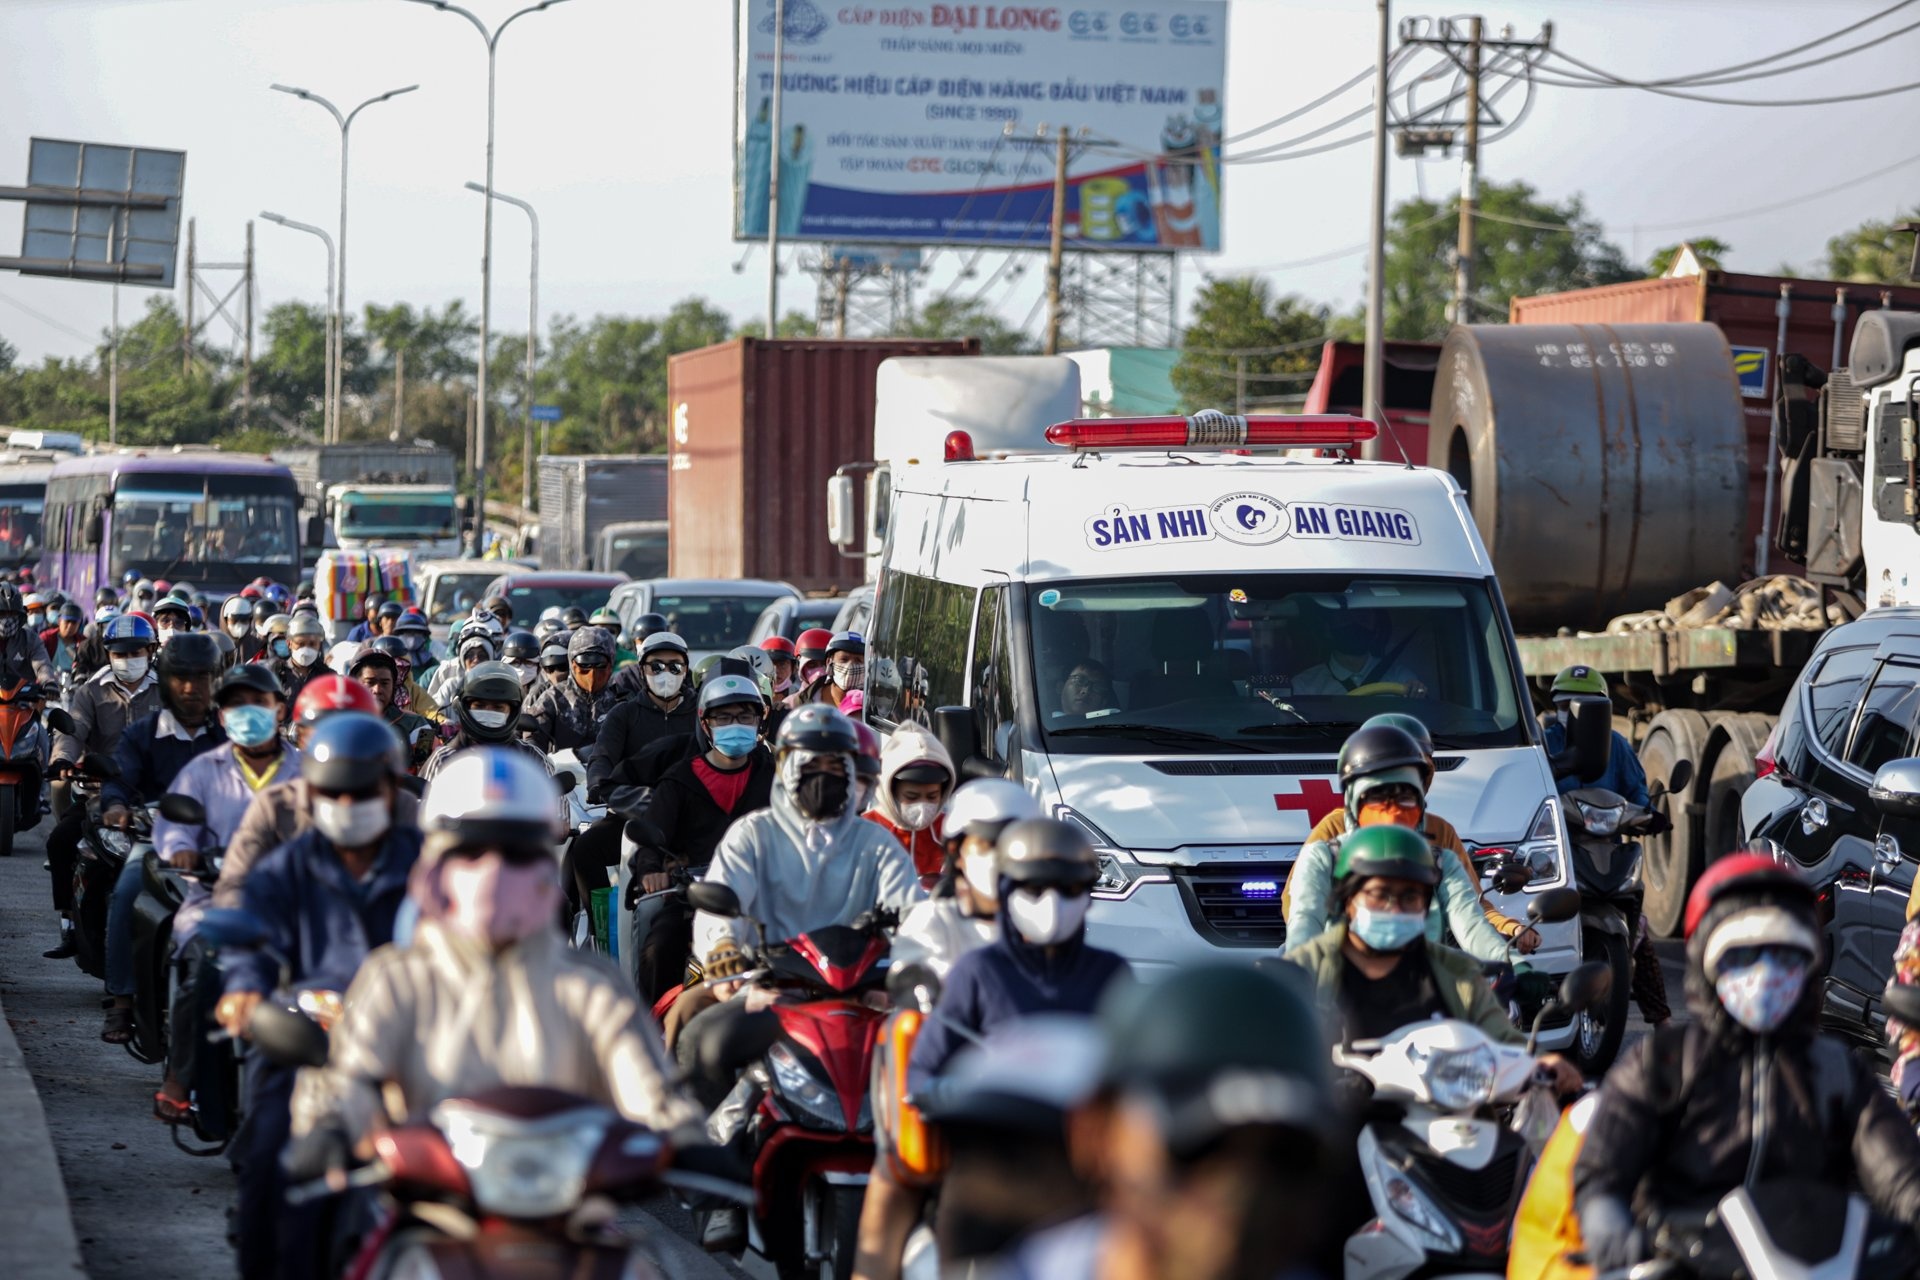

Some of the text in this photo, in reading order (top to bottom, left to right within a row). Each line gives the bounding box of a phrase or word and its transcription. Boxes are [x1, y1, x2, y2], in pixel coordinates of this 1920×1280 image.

[931, 4, 981, 34] ĐẠI
[985, 6, 1062, 32] LONG
[1139, 86, 1186, 104] NAM
[1092, 506, 1414, 547] SẢN NHI AN GIANG
